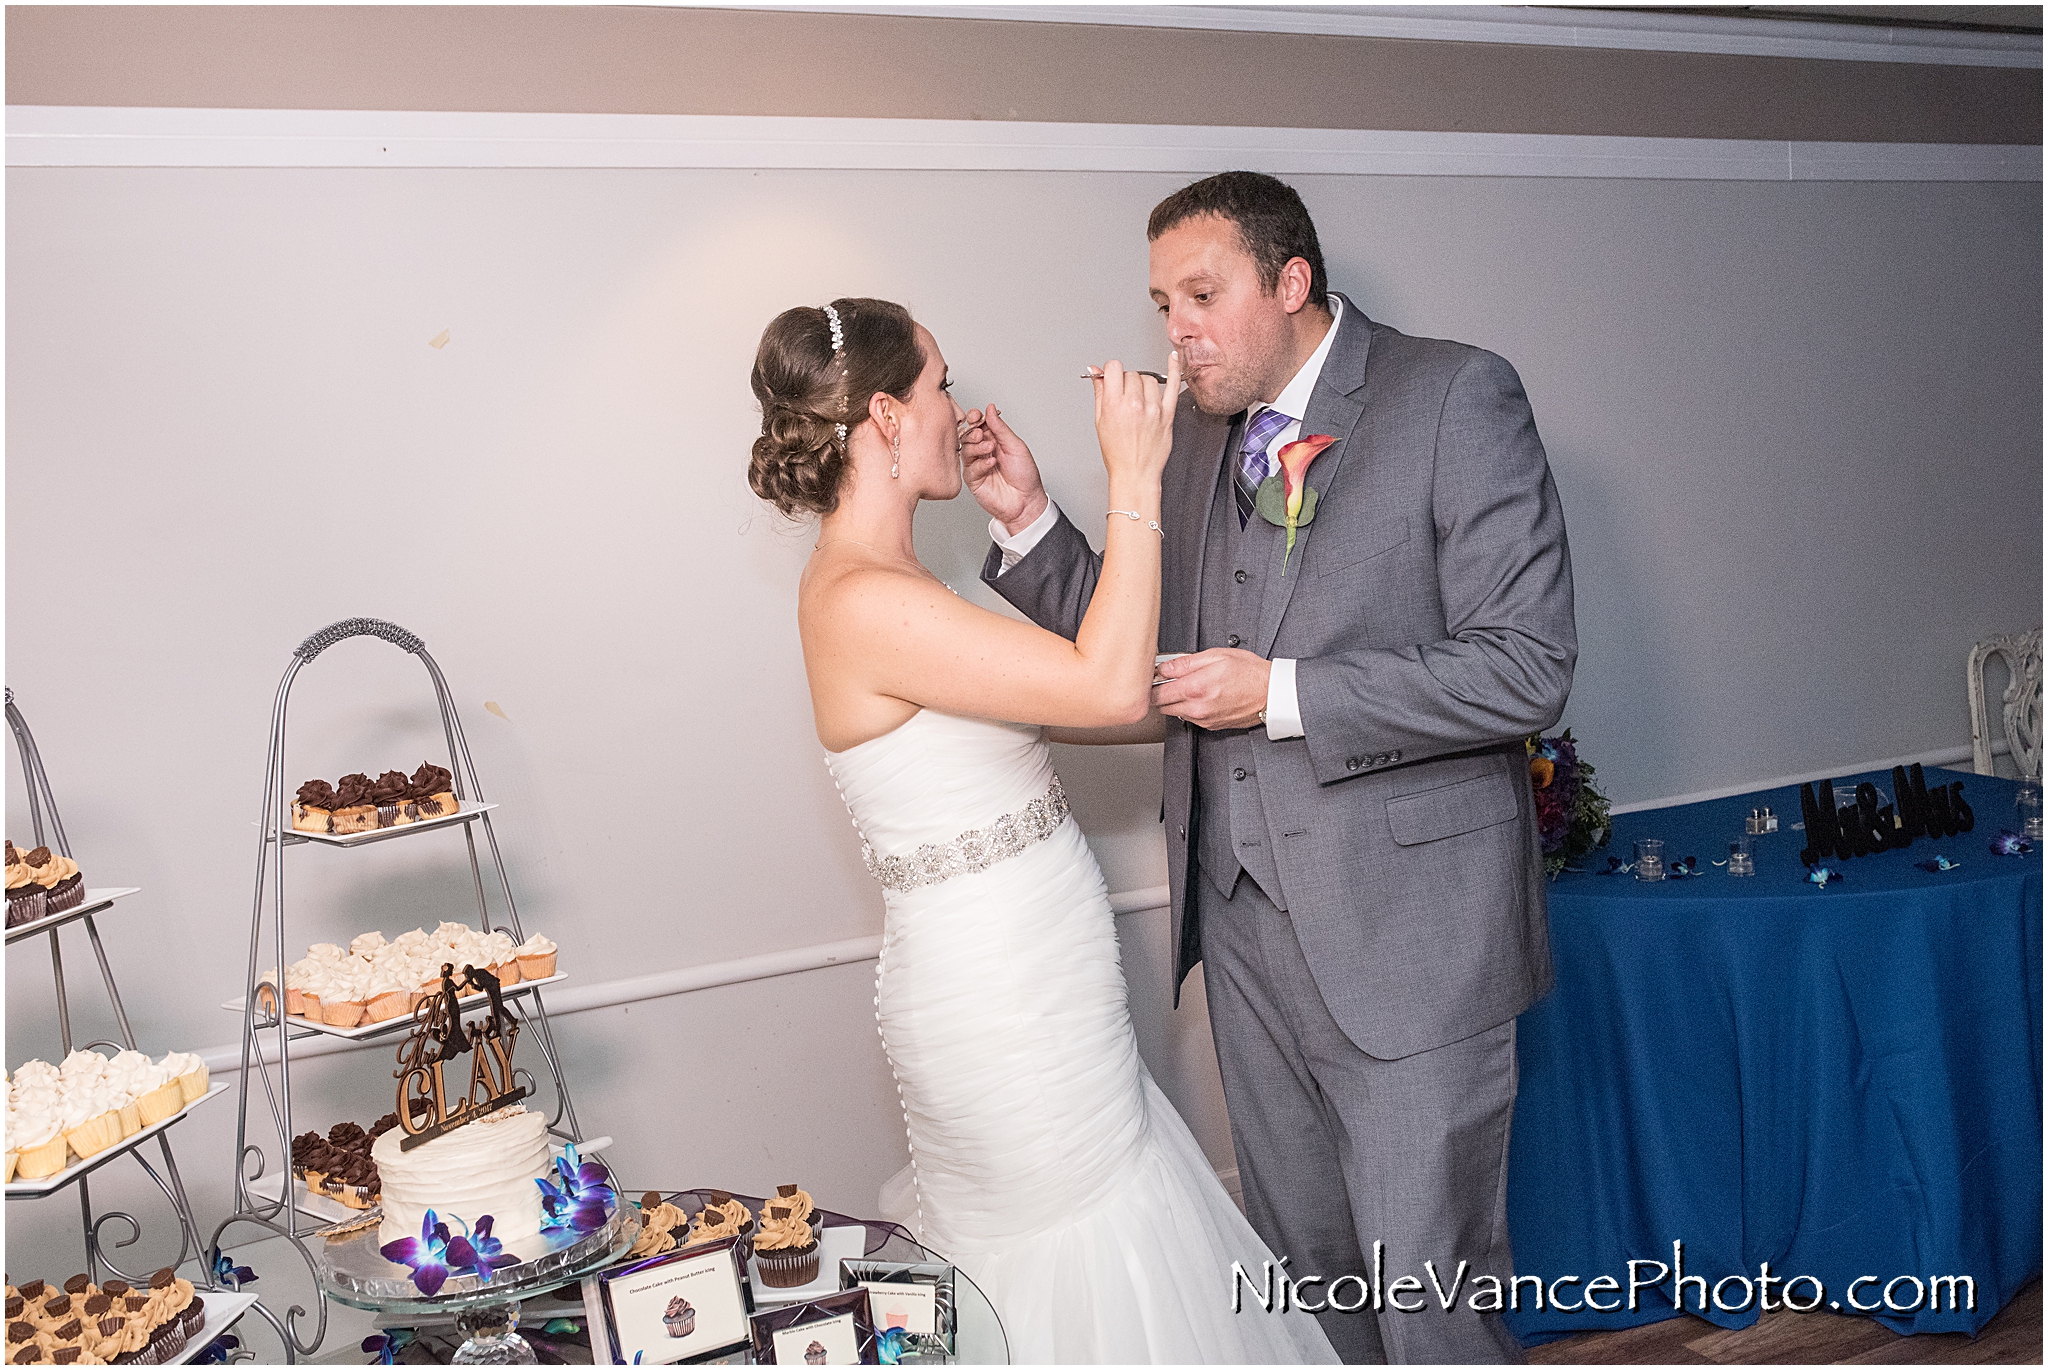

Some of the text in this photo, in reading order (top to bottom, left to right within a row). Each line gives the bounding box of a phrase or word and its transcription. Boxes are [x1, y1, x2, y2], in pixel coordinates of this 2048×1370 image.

[396, 1027, 520, 1135] CLAY
[478, 1102, 493, 1114] 2017
[629, 1285, 652, 1294] Chocolate
[674, 1274, 690, 1282] Peanut
[814, 1321, 832, 1329] Chocolate
